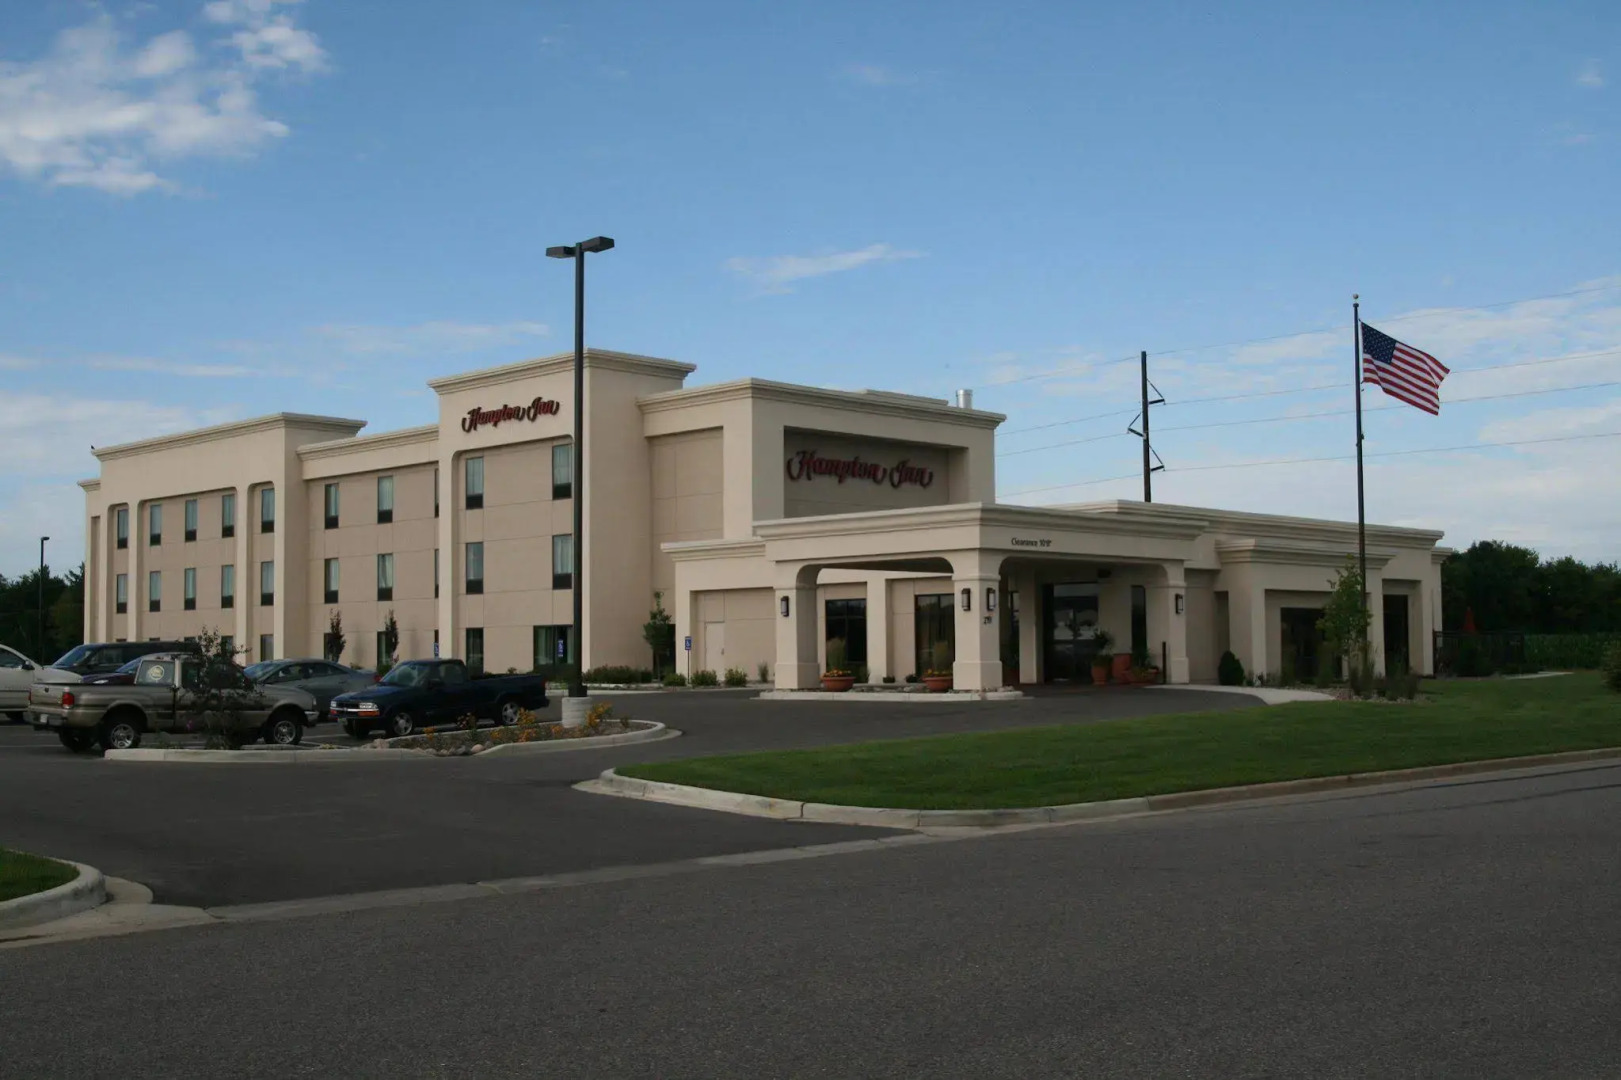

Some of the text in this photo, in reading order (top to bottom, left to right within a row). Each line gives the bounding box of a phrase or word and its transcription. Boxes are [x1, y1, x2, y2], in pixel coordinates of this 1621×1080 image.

[461, 396, 560, 433] Hampton Inn
[787, 450, 934, 489] Hampton Inn
